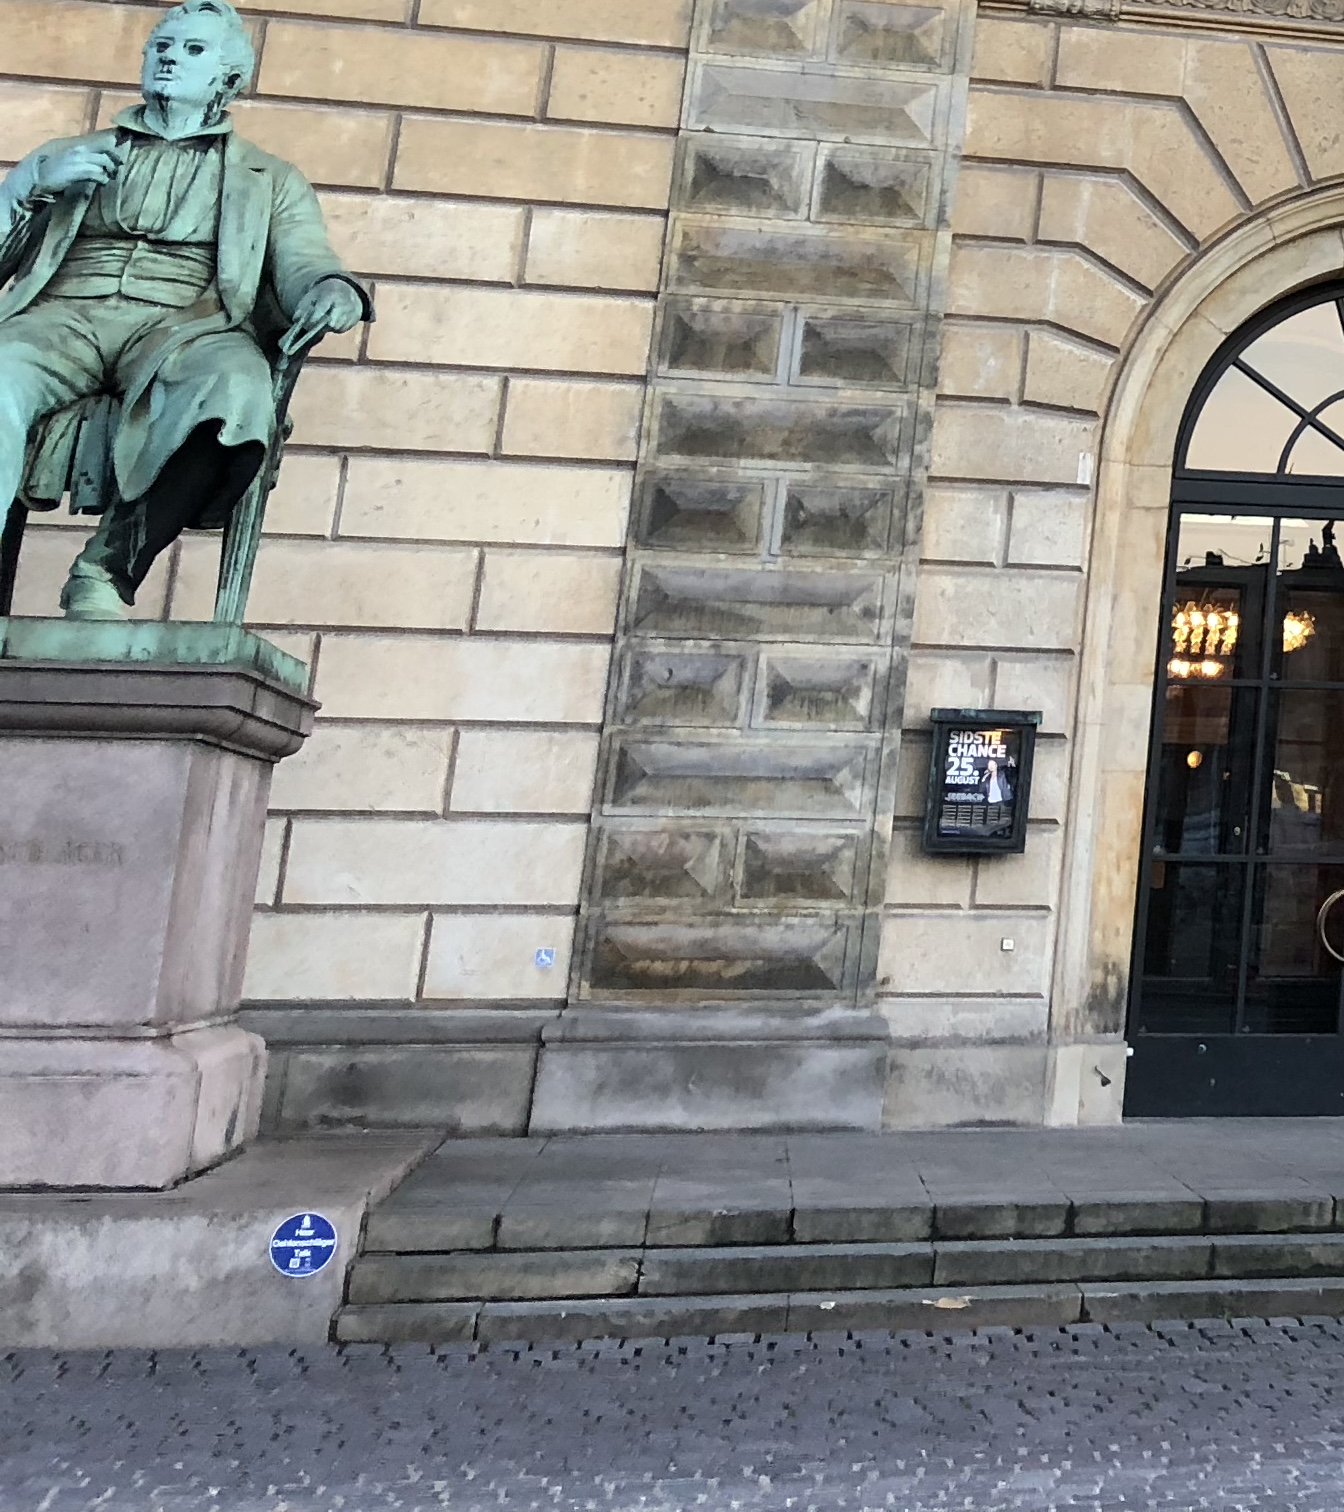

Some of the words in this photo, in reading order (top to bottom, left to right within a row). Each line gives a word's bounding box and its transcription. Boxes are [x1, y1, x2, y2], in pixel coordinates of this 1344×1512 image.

[949, 731, 1002, 744] SIDSTE
[948, 744, 1007, 758] CHANCE
[946, 757, 979, 776] 25.
[945, 776, 980, 785] AUGUST
